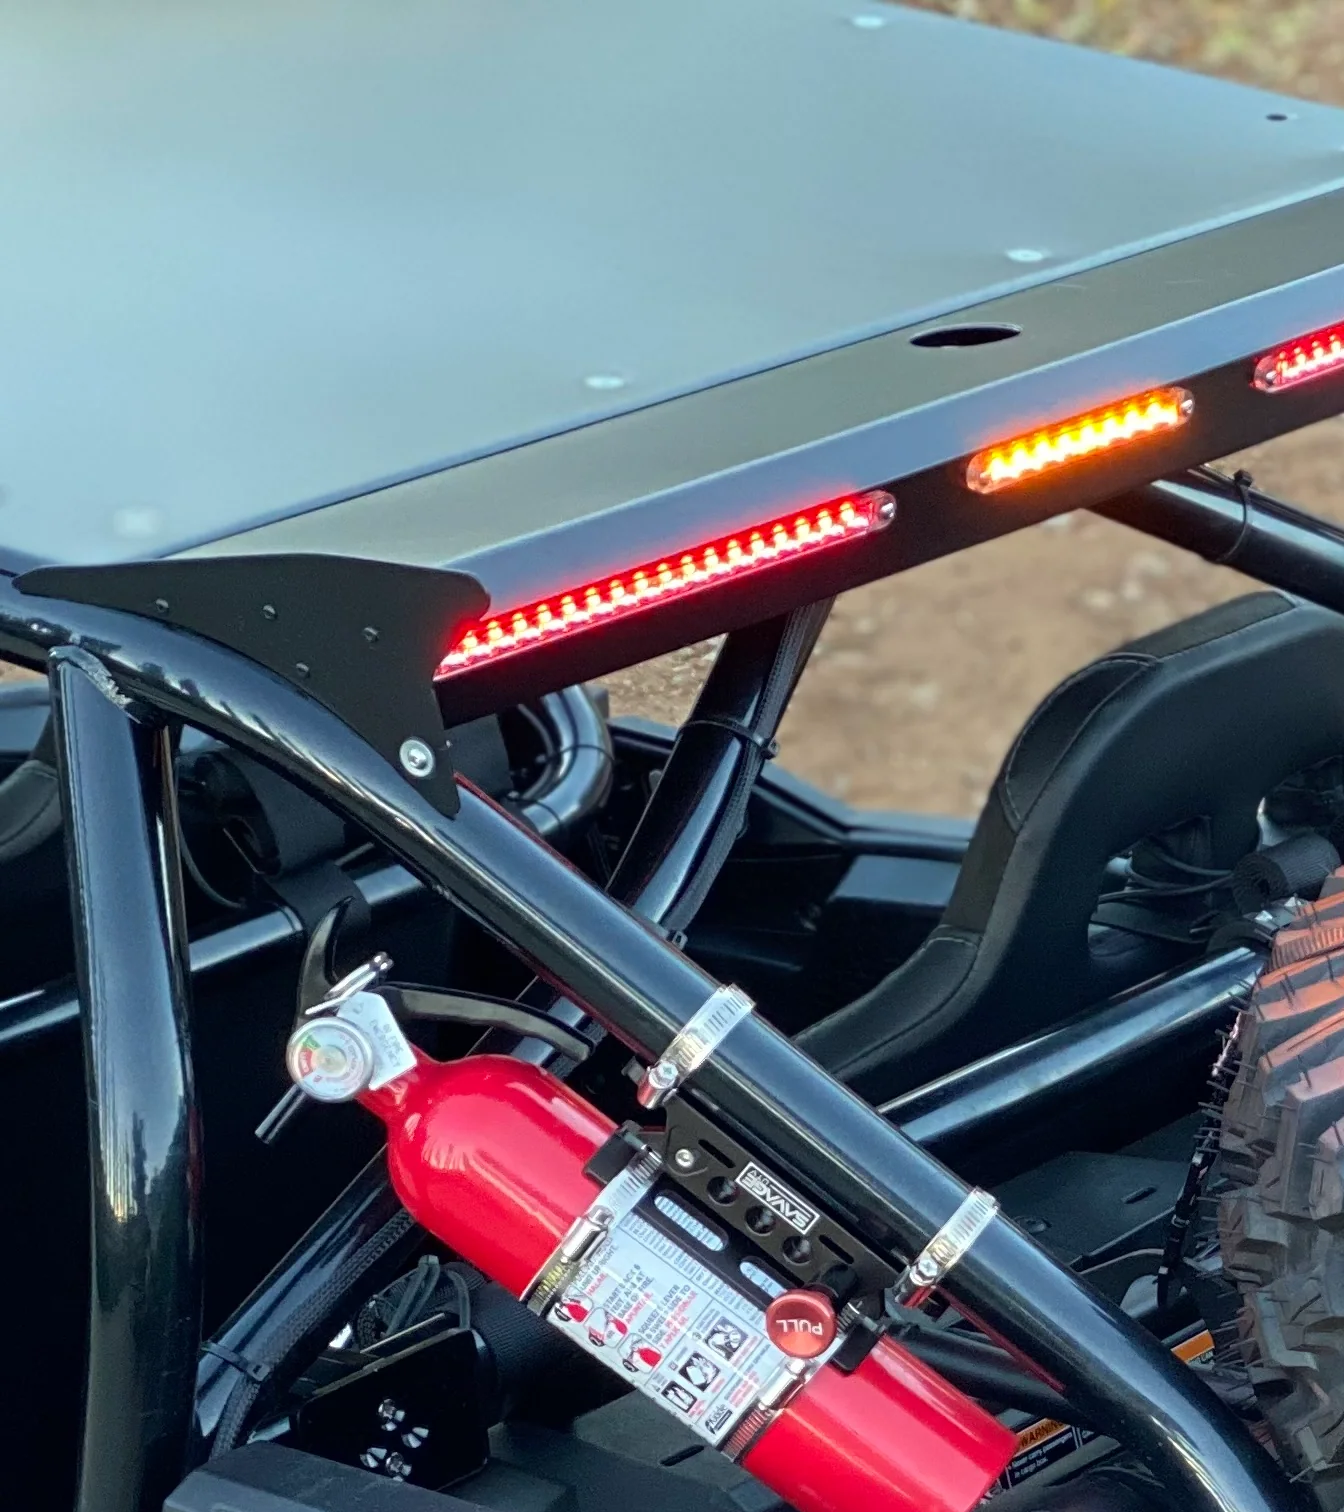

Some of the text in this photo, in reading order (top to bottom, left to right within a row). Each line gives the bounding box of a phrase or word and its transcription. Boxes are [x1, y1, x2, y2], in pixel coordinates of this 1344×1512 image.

[747, 1169, 770, 1185] UTV
[741, 1175, 810, 1228] SAVAGE
[775, 1318, 823, 1335] PULL
